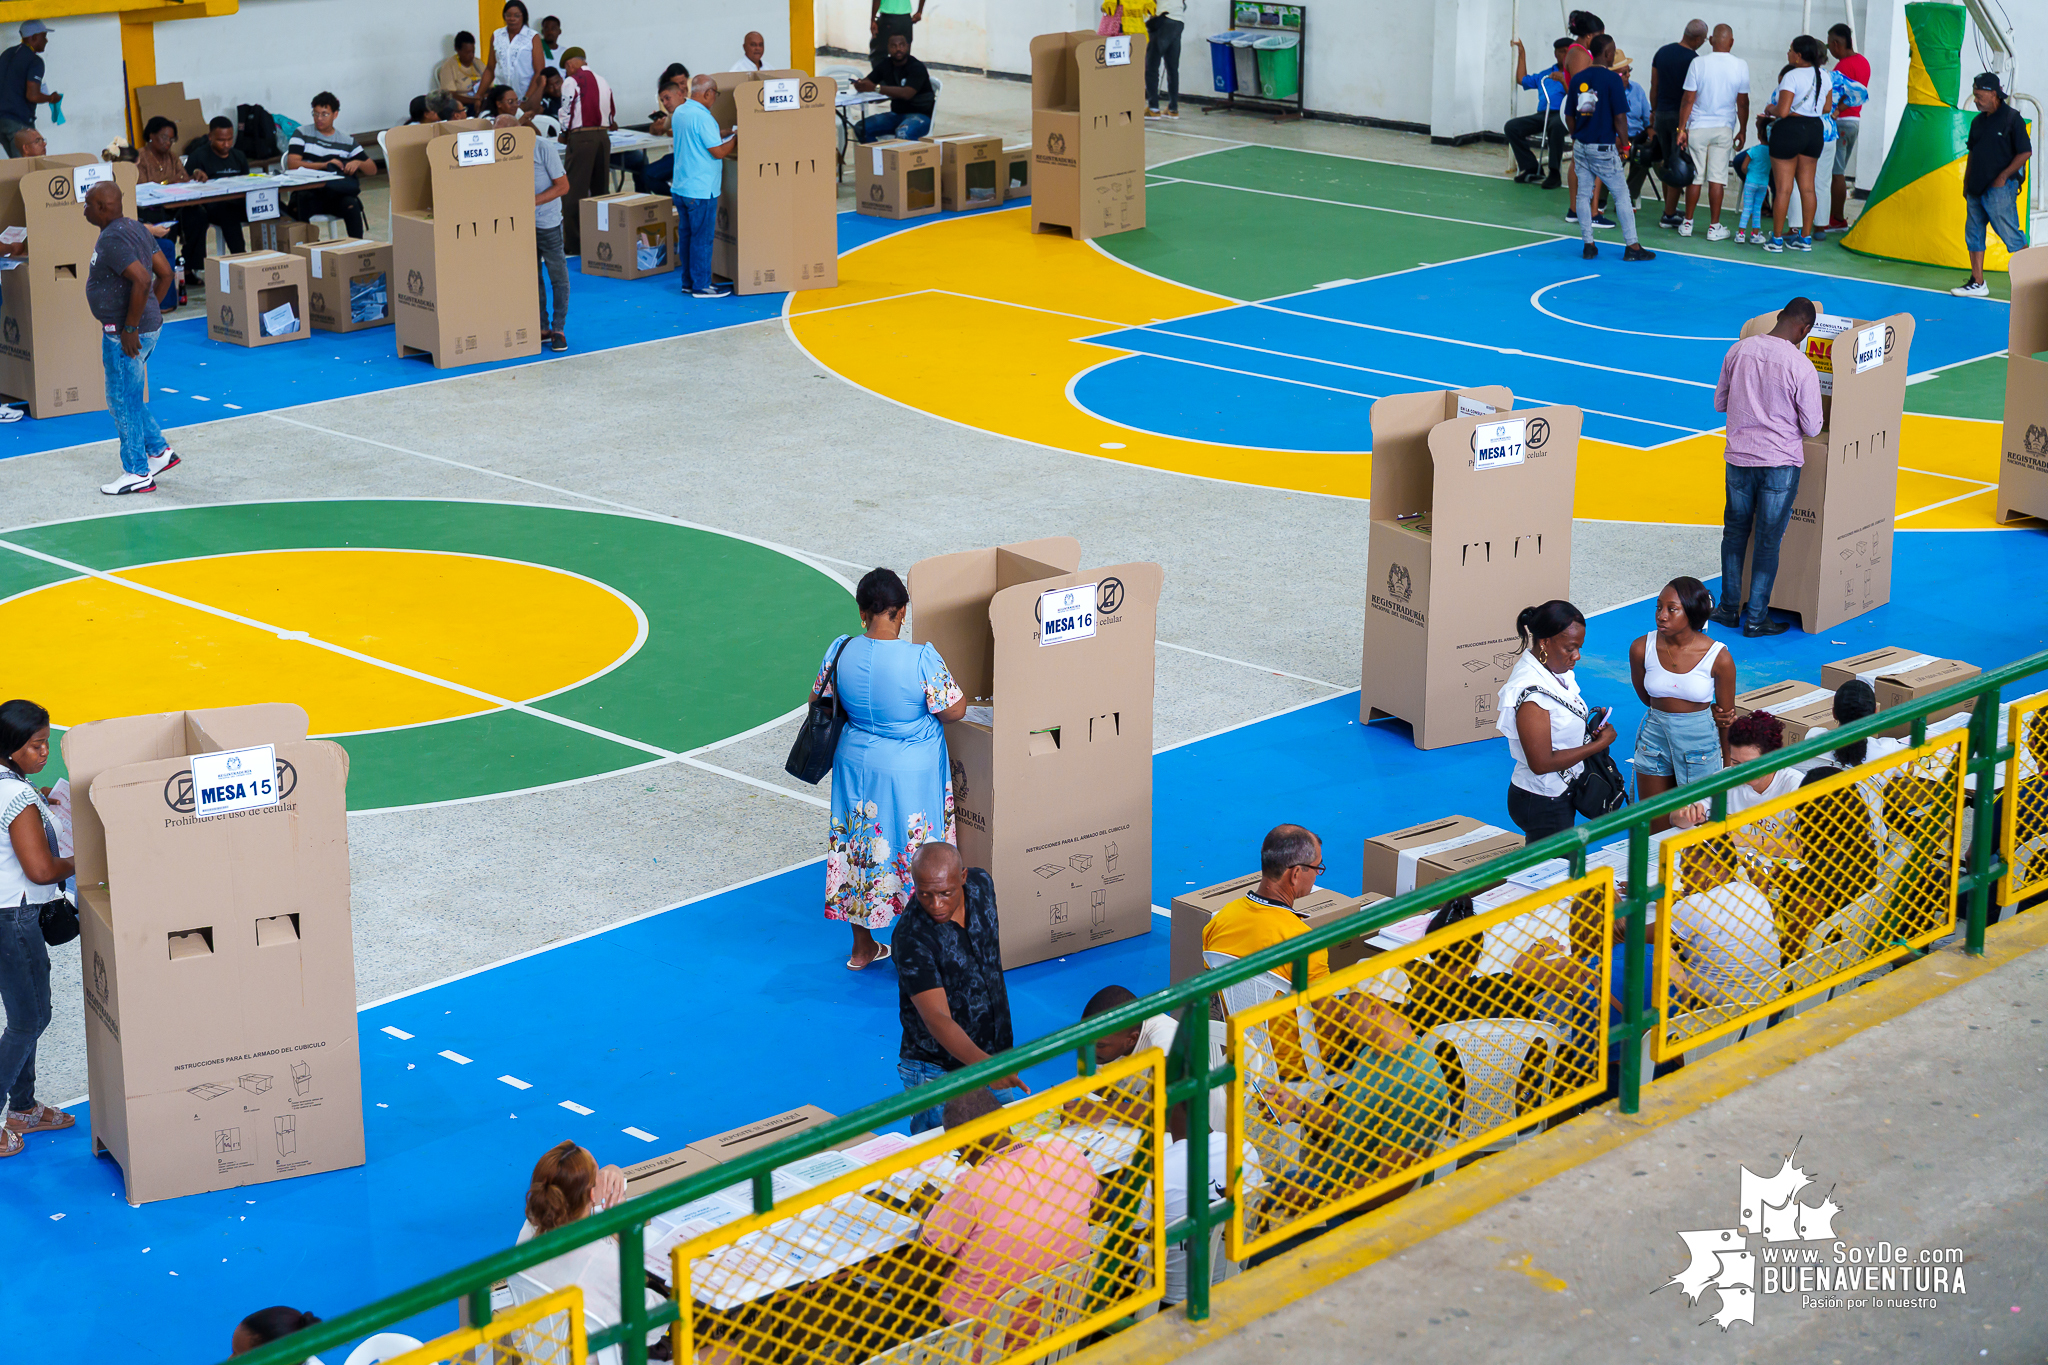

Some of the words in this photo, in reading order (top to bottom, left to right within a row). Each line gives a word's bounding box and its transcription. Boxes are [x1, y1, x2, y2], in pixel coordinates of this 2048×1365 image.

[769, 95, 788, 104] MESA
[789, 94, 794, 103] 2
[464, 148, 483, 158] MESA
[484, 148, 489, 157] 3
[252, 204, 268, 215] MESA
[269, 204, 274, 212] 3
[1859, 350, 1874, 364] MESA
[1874, 346, 1882, 358] 18
[1479, 446, 1506, 460] MESA
[1508, 444, 1522, 456] 17
[1526, 450, 1548, 459] celular
[1371, 594, 1425, 622] REGISTRADURÍA
[1045, 616, 1075, 635] MESA
[1078, 613, 1092, 628] 16
[1100, 614, 1123, 626] celular
[1456, 640, 1487, 650] INSTRUCCIONES
[202, 783, 246, 804] MESA
[250, 778, 272, 796] 15
[164, 814, 214, 828] Prohibido
[263, 802, 297, 814] celular
[974, 823, 986, 832] CIVIL
[1026, 840, 1061, 854] INSTRUCCIONES
[1080, 832, 1098, 841] ARMADO
[174, 1058, 225, 1071] INSTRUCCIONES
[252, 1048, 280, 1058] ARMADO
[294, 1042, 326, 1051] CUBICULO
[718, 1129, 754, 1143] DEPOSITE
[754, 1124, 764, 1132] SU
[764, 1118, 784, 1128] VOTO
[624, 1168, 635, 1176] SU
[636, 1162, 657, 1172] VOTO
